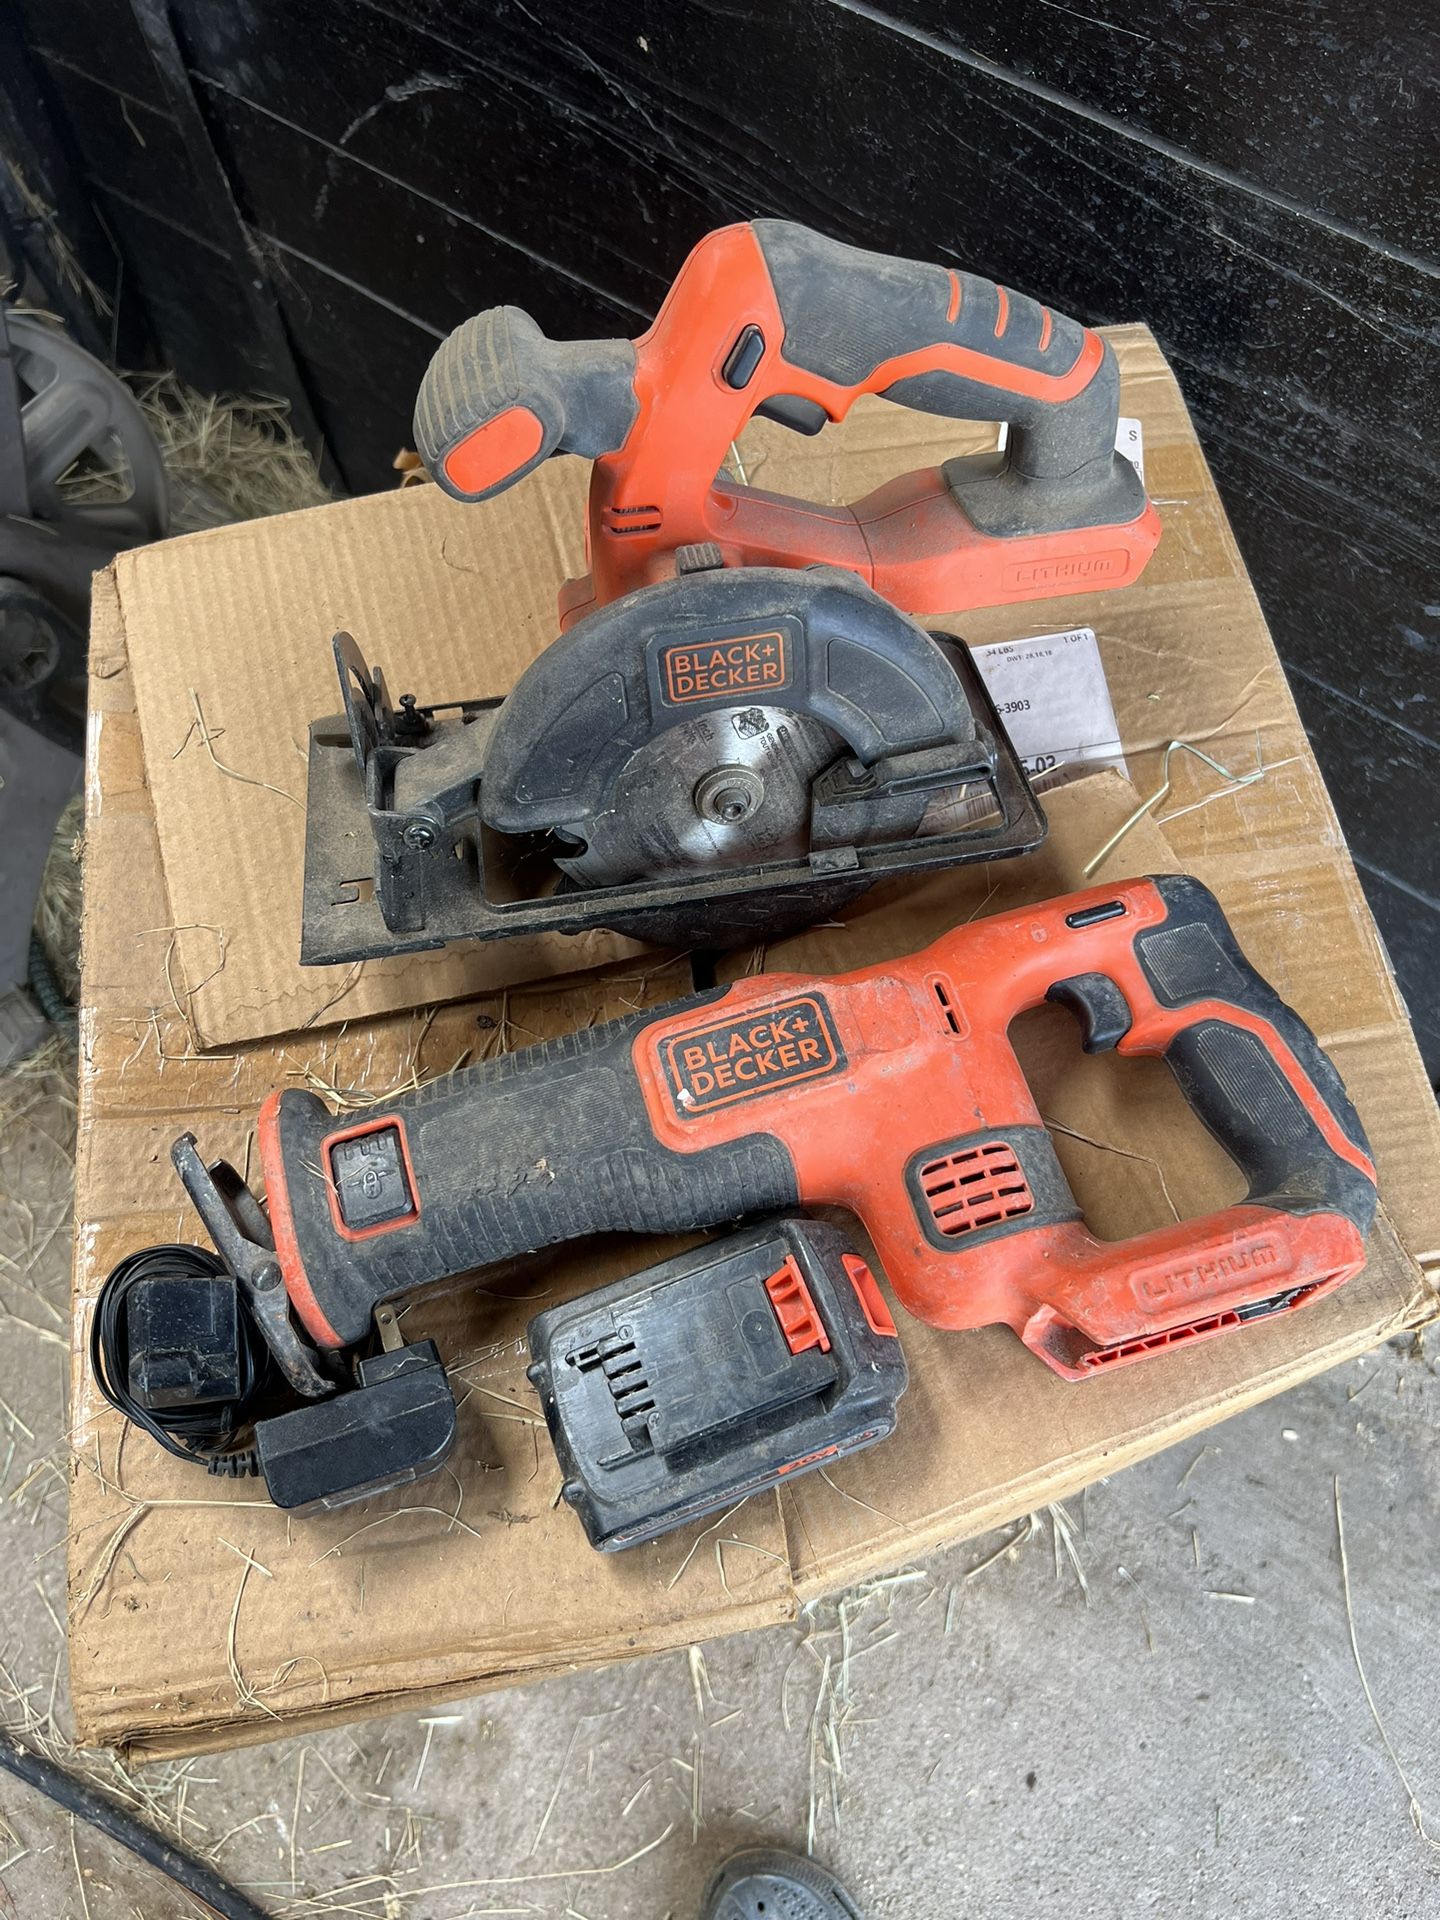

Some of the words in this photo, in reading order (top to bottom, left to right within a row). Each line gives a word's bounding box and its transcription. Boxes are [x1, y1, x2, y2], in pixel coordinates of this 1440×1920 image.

[1128, 430, 1138, 442] S
[1016, 558, 1110, 582] LITHIUM
[674, 643, 775, 674] BLACK+
[677, 662, 778, 694] DECKER
[683, 1016, 809, 1071] BLACK+
[690, 1038, 823, 1096] DECKER
[1142, 1245, 1277, 1297] LITHIUM
